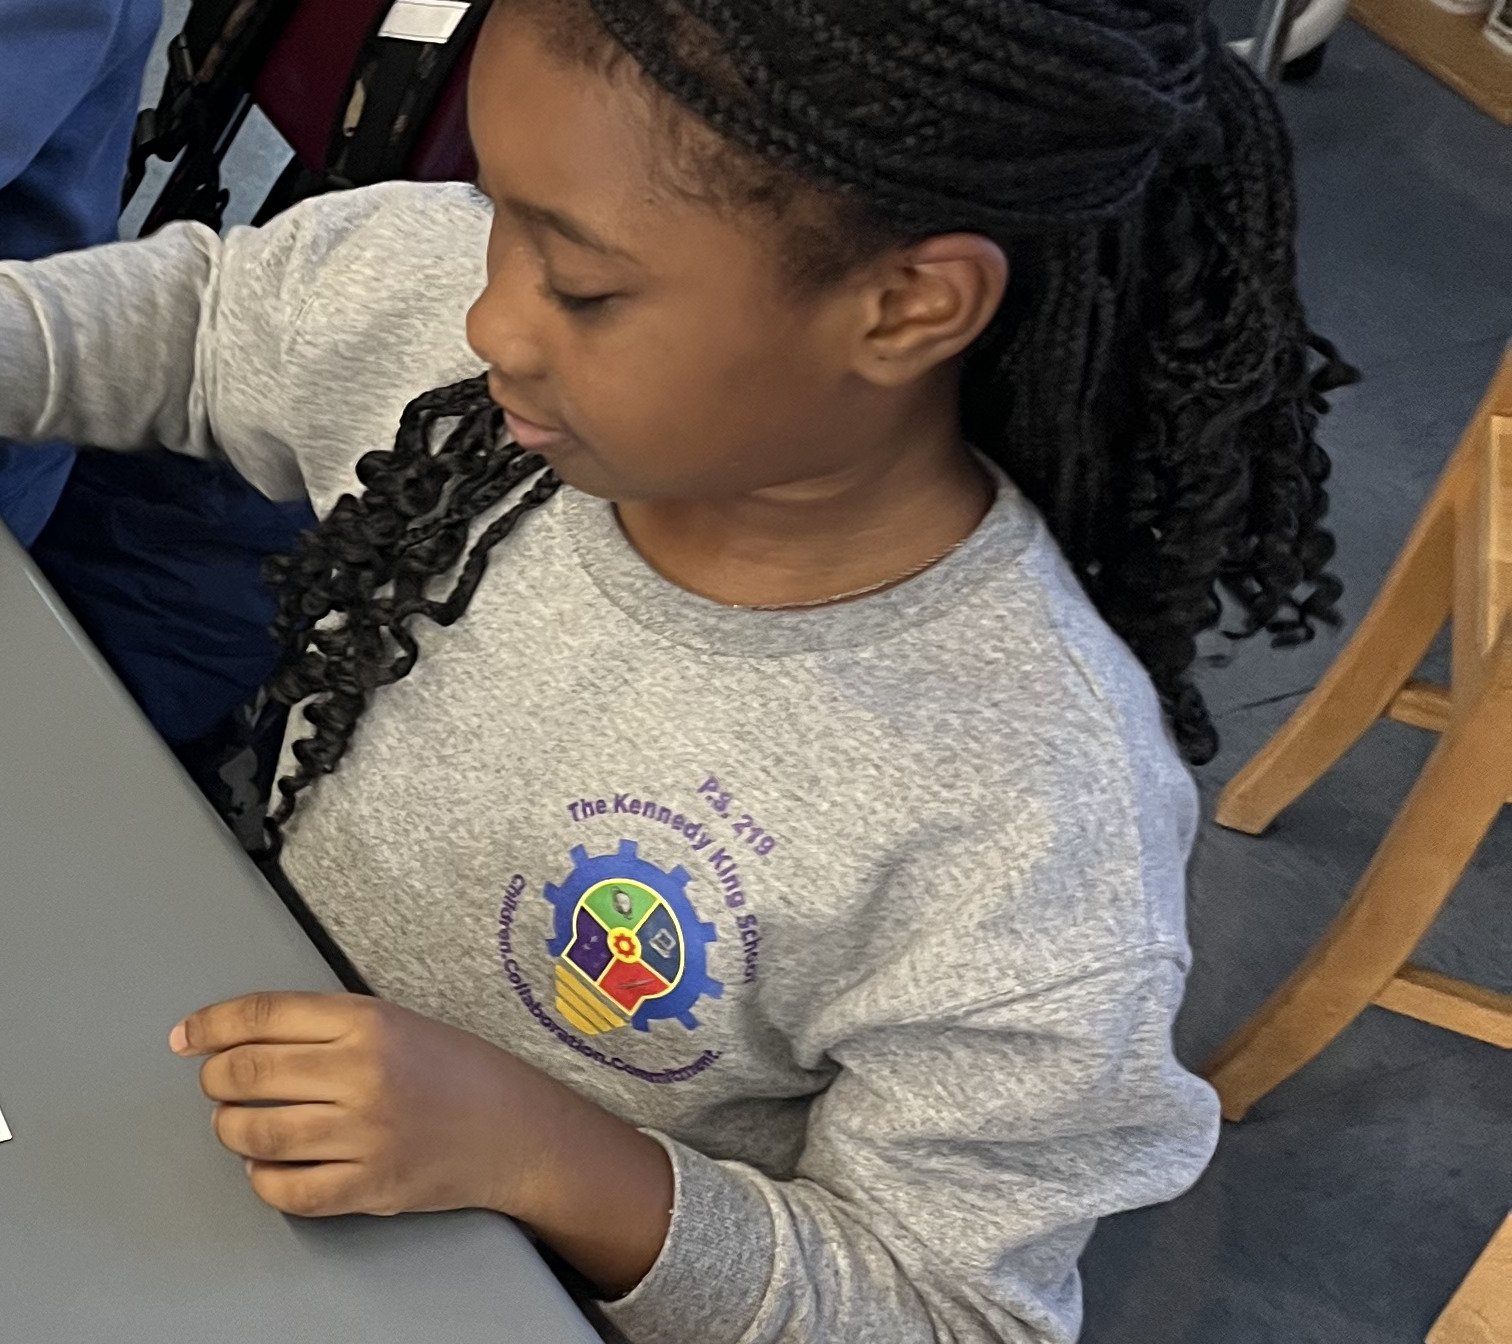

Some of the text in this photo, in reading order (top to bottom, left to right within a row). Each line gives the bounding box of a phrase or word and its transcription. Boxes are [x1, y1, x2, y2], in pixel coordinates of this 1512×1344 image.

[567, 796, 608, 822] The
[612, 792, 714, 852] Kennedy
[707, 848, 746, 909] King
[731, 813, 776, 856] 219
